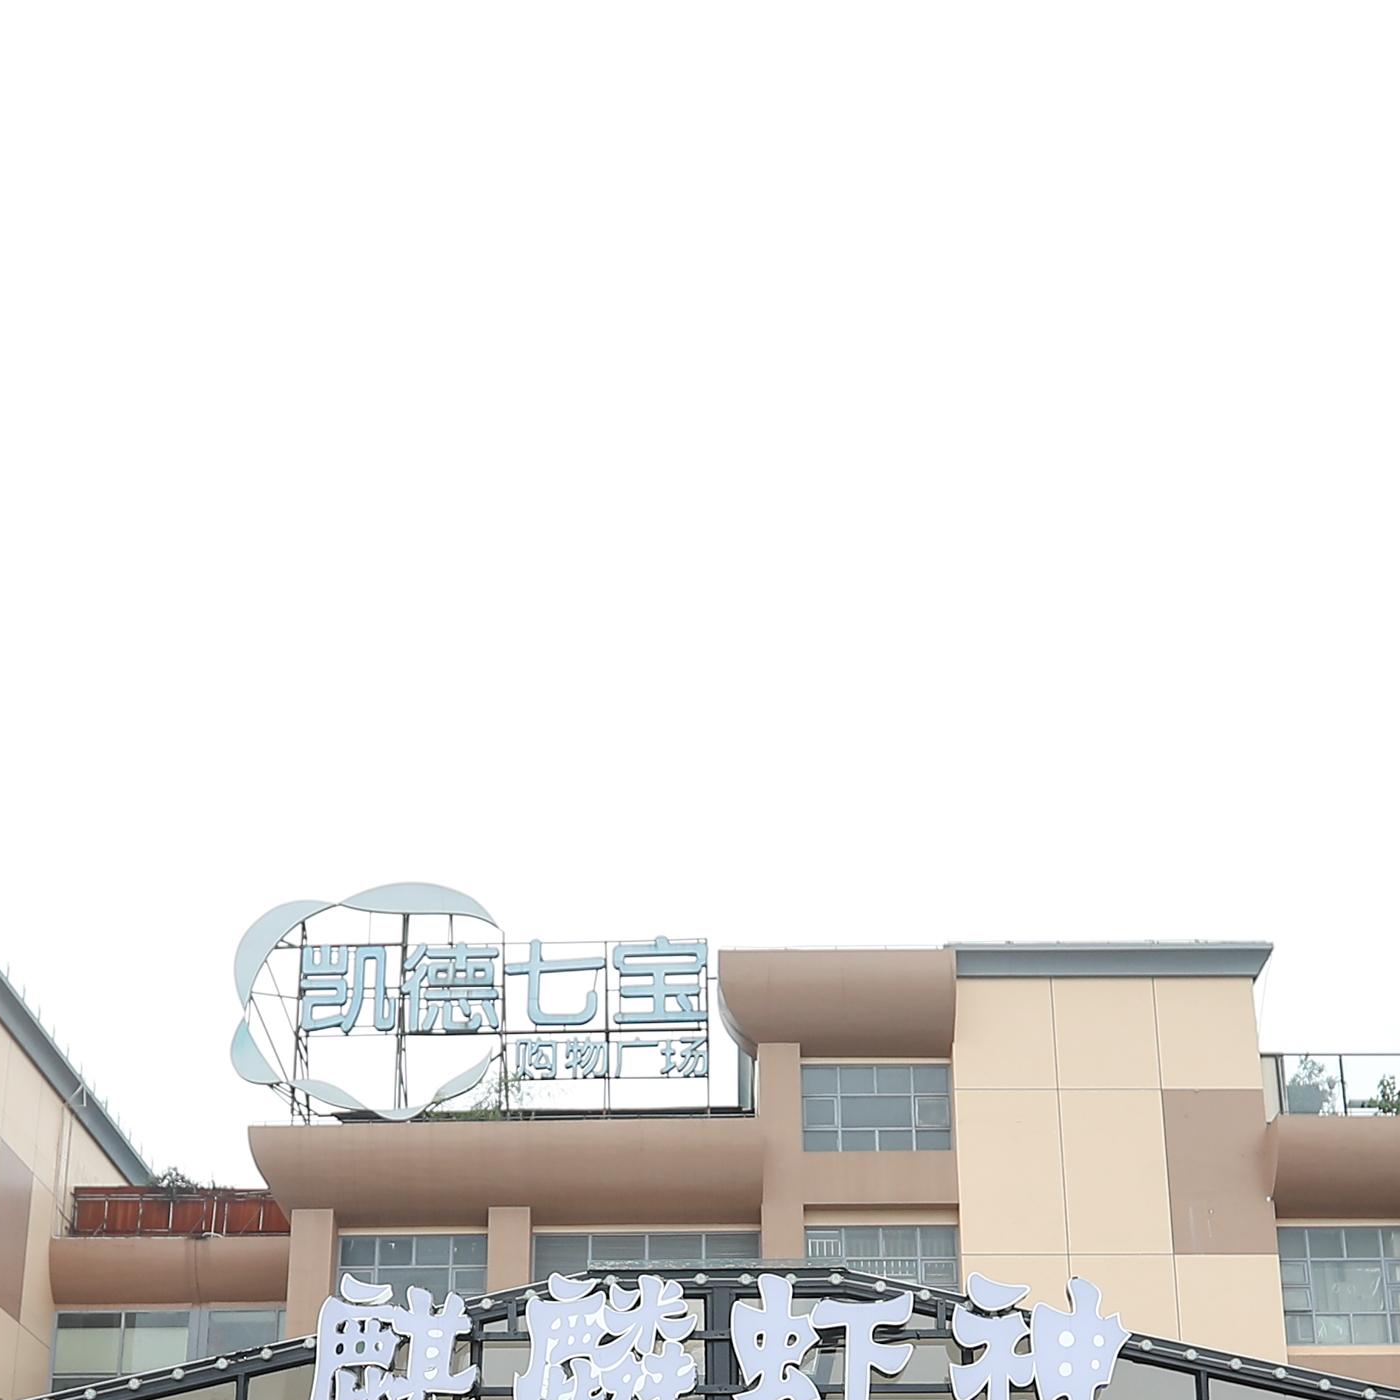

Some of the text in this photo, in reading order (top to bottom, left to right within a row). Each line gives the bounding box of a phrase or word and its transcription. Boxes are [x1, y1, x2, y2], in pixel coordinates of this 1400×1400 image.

[302, 936, 708, 1034] 凯德七宝
[515, 1037, 708, 1080] 购物广场
